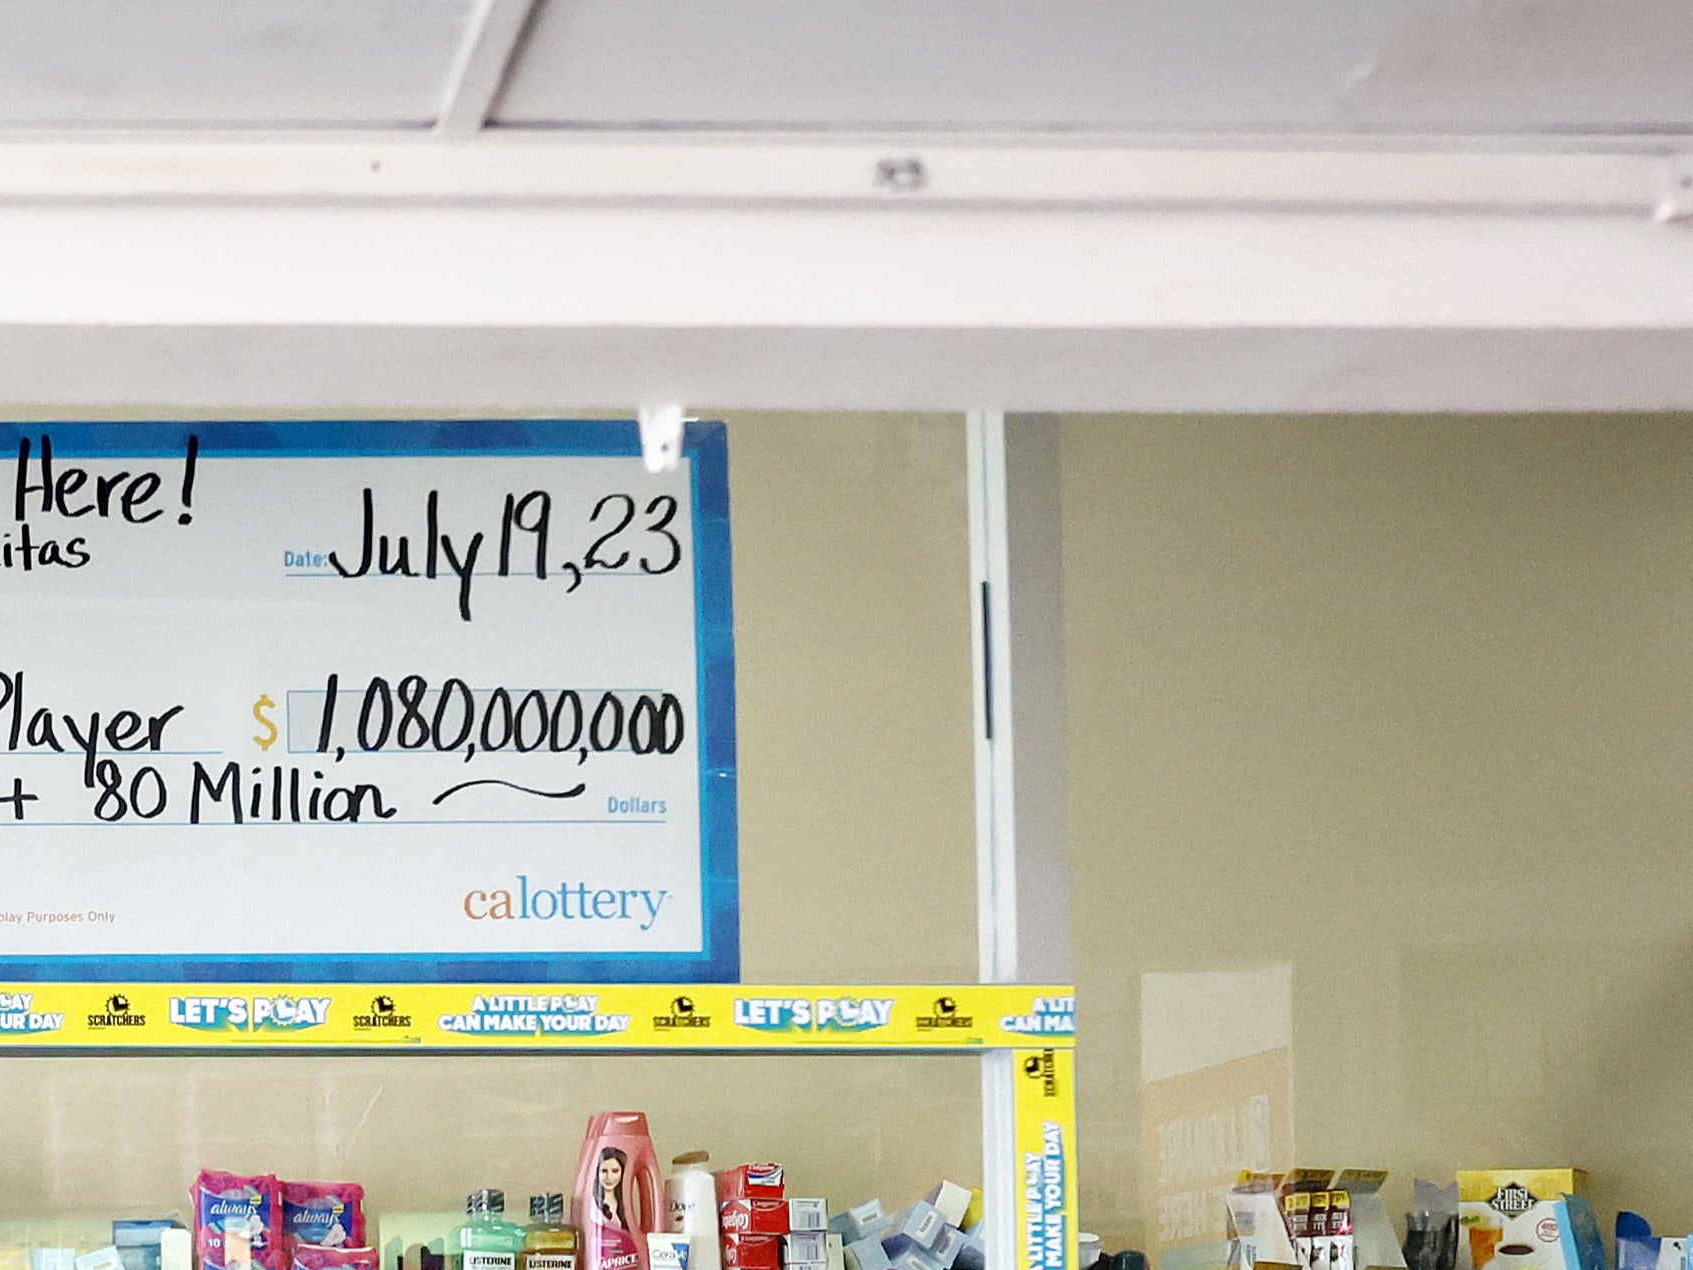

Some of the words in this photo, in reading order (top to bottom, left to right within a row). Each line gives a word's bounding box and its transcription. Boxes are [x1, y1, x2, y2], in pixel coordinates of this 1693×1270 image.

[15, 435, 198, 526] Here!
[284, 550, 327, 567] Date:
[328, 487, 484, 622] July
[497, 489, 682, 593] 19,23
[252, 694, 278, 751] $
[316, 673, 684, 763] 1,080,000,000
[93, 759, 167, 822] 80
[191, 759, 397, 824] Million
[607, 796, 667, 814] Dollars
[463, 875, 668, 931] calottery
[26, 910, 85, 927] Purposes
[88, 910, 116, 926] Only
[734, 999, 810, 1025] LET'S
[211, 1200, 258, 1219] always
[293, 1210, 340, 1227] always
[208, 1238, 221, 1248] 10
[469, 1256, 512, 1266] LISTERINE
[529, 1259, 573, 1269] LISTERINE
